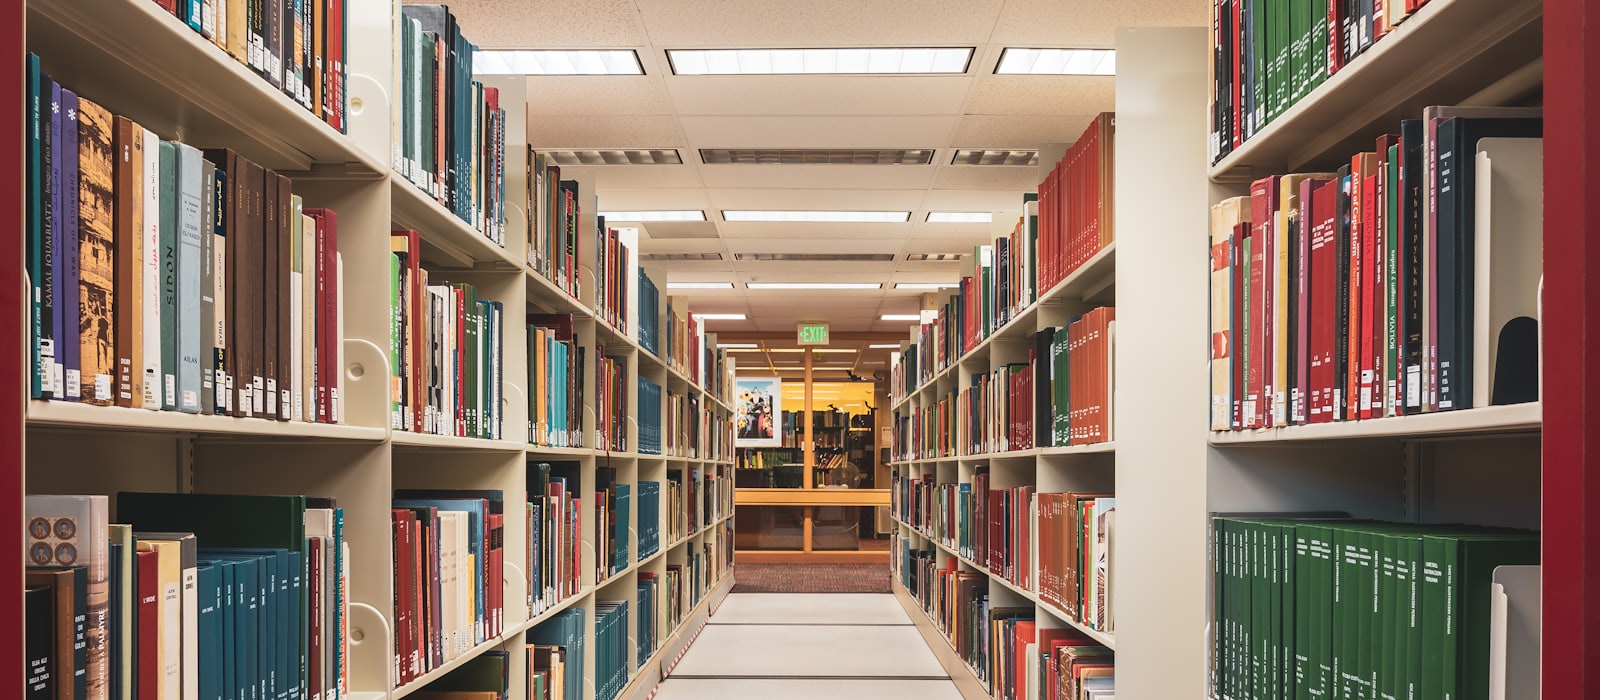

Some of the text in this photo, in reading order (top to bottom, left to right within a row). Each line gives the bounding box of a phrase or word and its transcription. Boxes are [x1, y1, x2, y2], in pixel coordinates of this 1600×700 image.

[1353, 197, 1359, 205] of
[71, 230, 75, 241] OF
[166, 246, 174, 305] SIDON
[804, 326, 824, 342] EXIT
[184, 356, 197, 364] ATLAS
